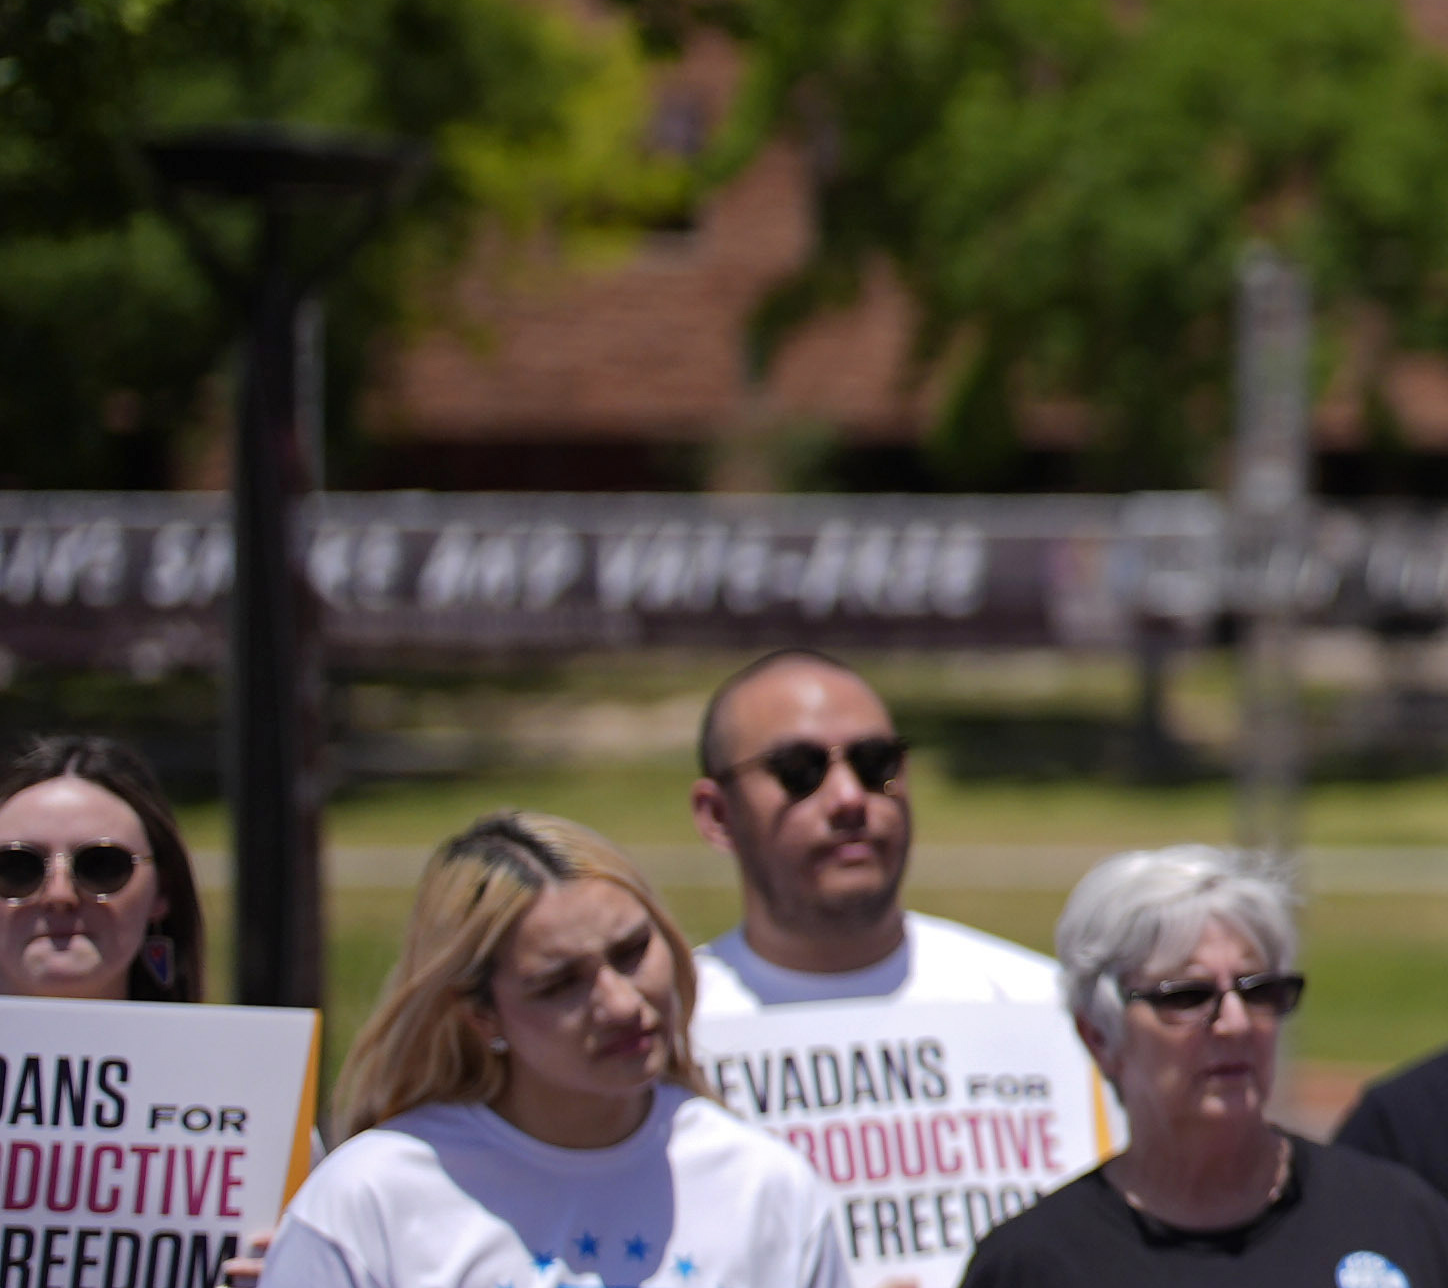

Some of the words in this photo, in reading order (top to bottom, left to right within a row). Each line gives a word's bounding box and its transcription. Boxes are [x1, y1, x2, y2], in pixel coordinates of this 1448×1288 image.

[704, 1036, 948, 1113] EVADANS
[966, 1073, 1050, 1100] FOR
[149, 1104, 248, 1132] FOR
